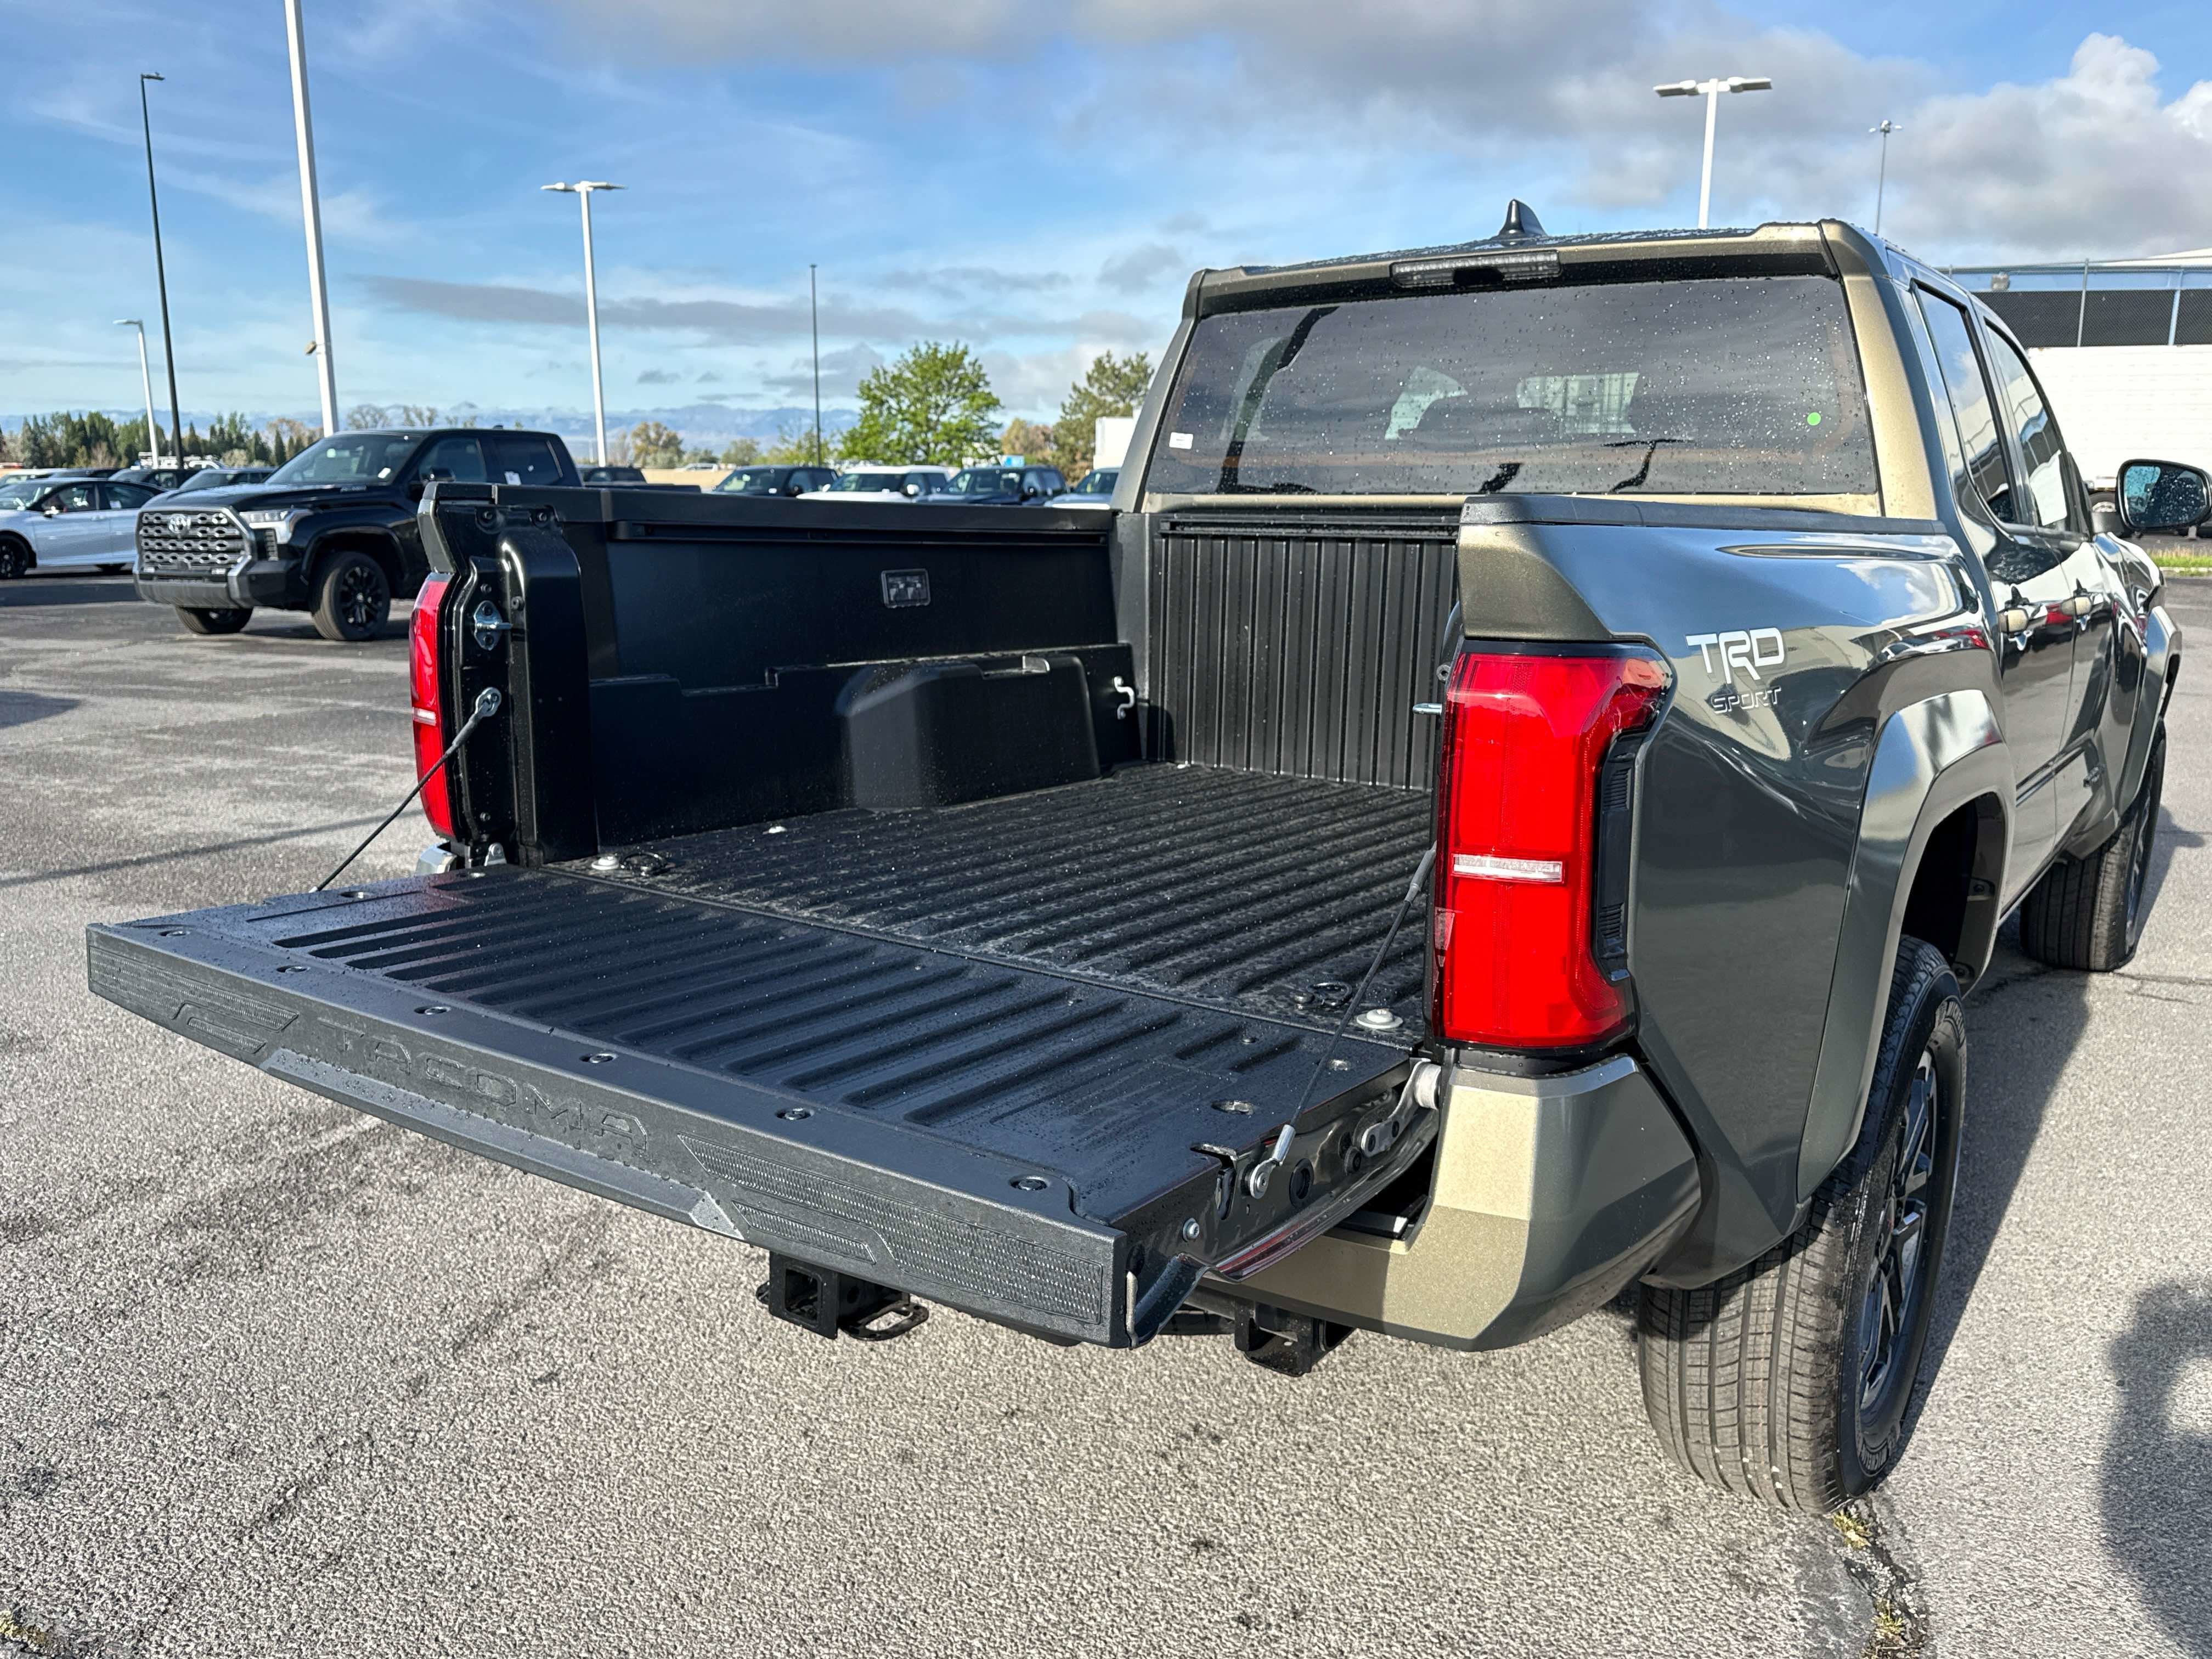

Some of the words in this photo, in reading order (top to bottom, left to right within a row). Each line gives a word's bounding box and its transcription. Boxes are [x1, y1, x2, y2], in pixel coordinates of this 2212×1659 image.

[1686, 628, 1784, 684] TRD
[1711, 686, 1781, 714] SPORT
[317, 1017, 648, 1152] TACOMA
